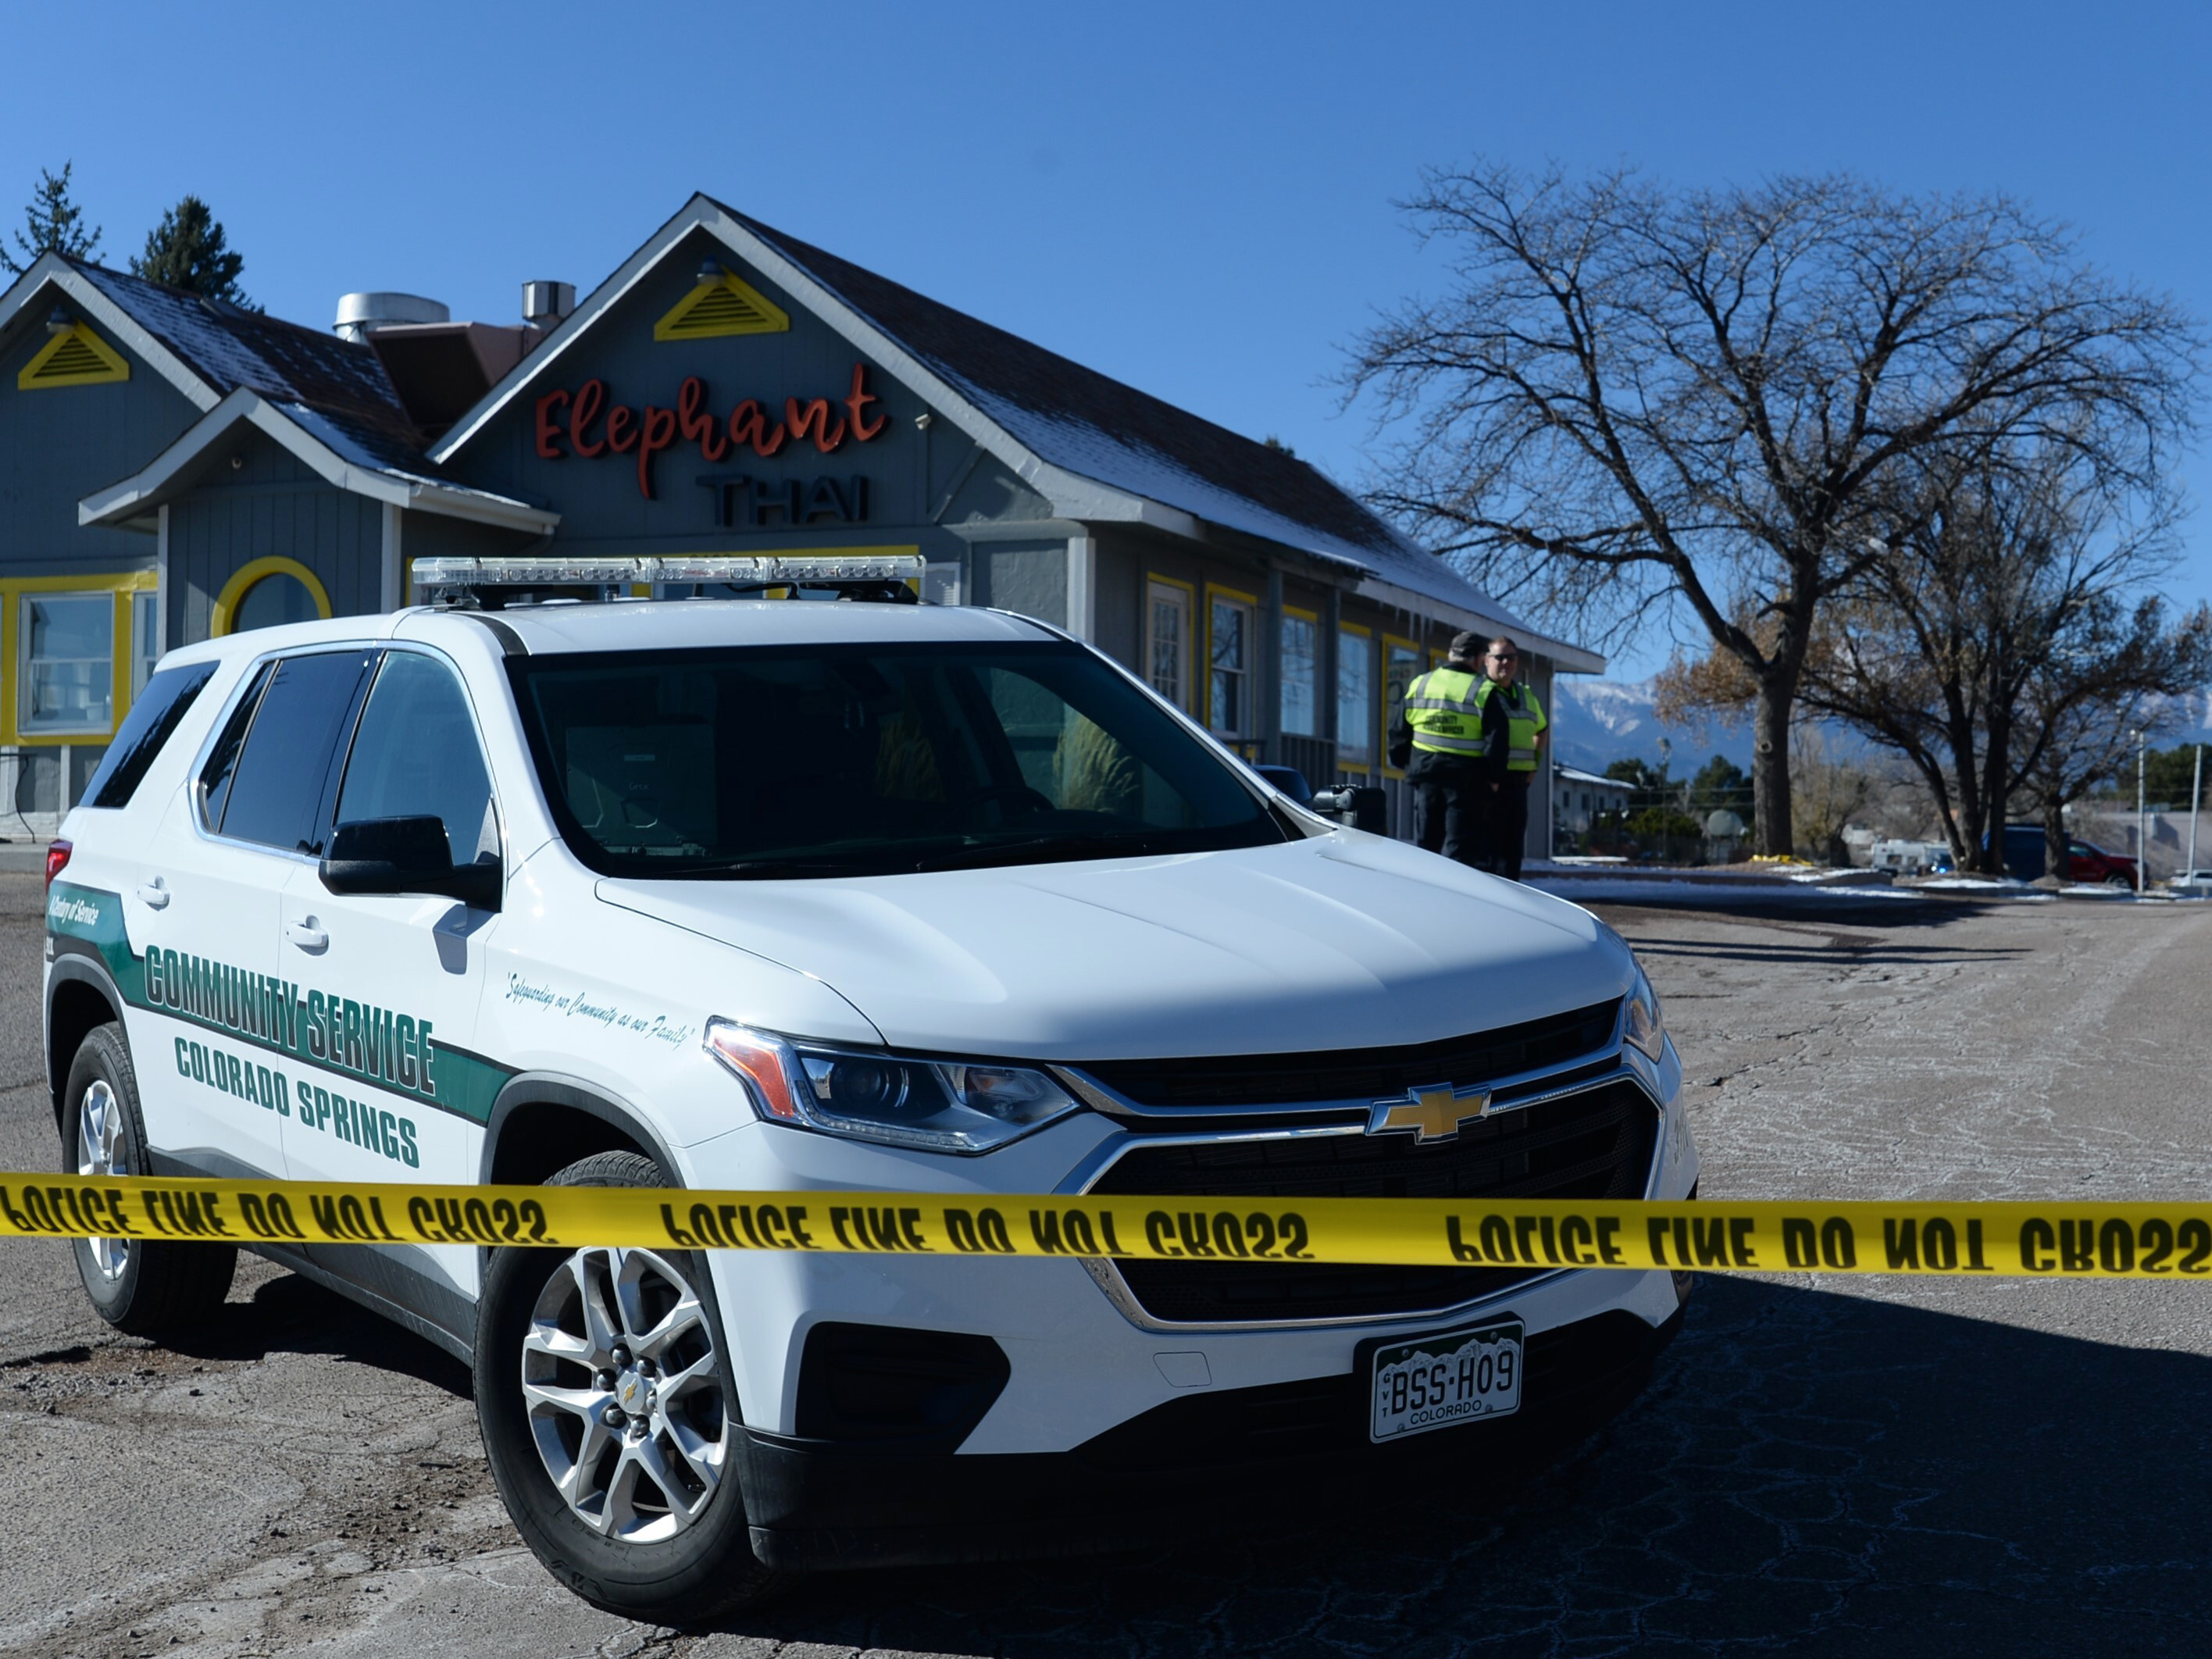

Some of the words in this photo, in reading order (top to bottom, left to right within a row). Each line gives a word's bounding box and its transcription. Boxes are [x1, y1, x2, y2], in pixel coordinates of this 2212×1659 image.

[535, 362, 886, 500] Elephant
[696, 474, 869, 526] THAI
[74, 899, 99, 926] Service
[144, 944, 299, 1051] COMMUNITY
[306, 989, 436, 1097] SERVICE
[555, 996, 569, 1009] our
[566, 991, 618, 1029] Community
[617, 1014, 632, 1027] as
[630, 1019, 648, 1032] our
[174, 1036, 291, 1117] COLORADO
[297, 1080, 420, 1169] SPRINGS
[1410, 1399, 1482, 1425] COLORADO
